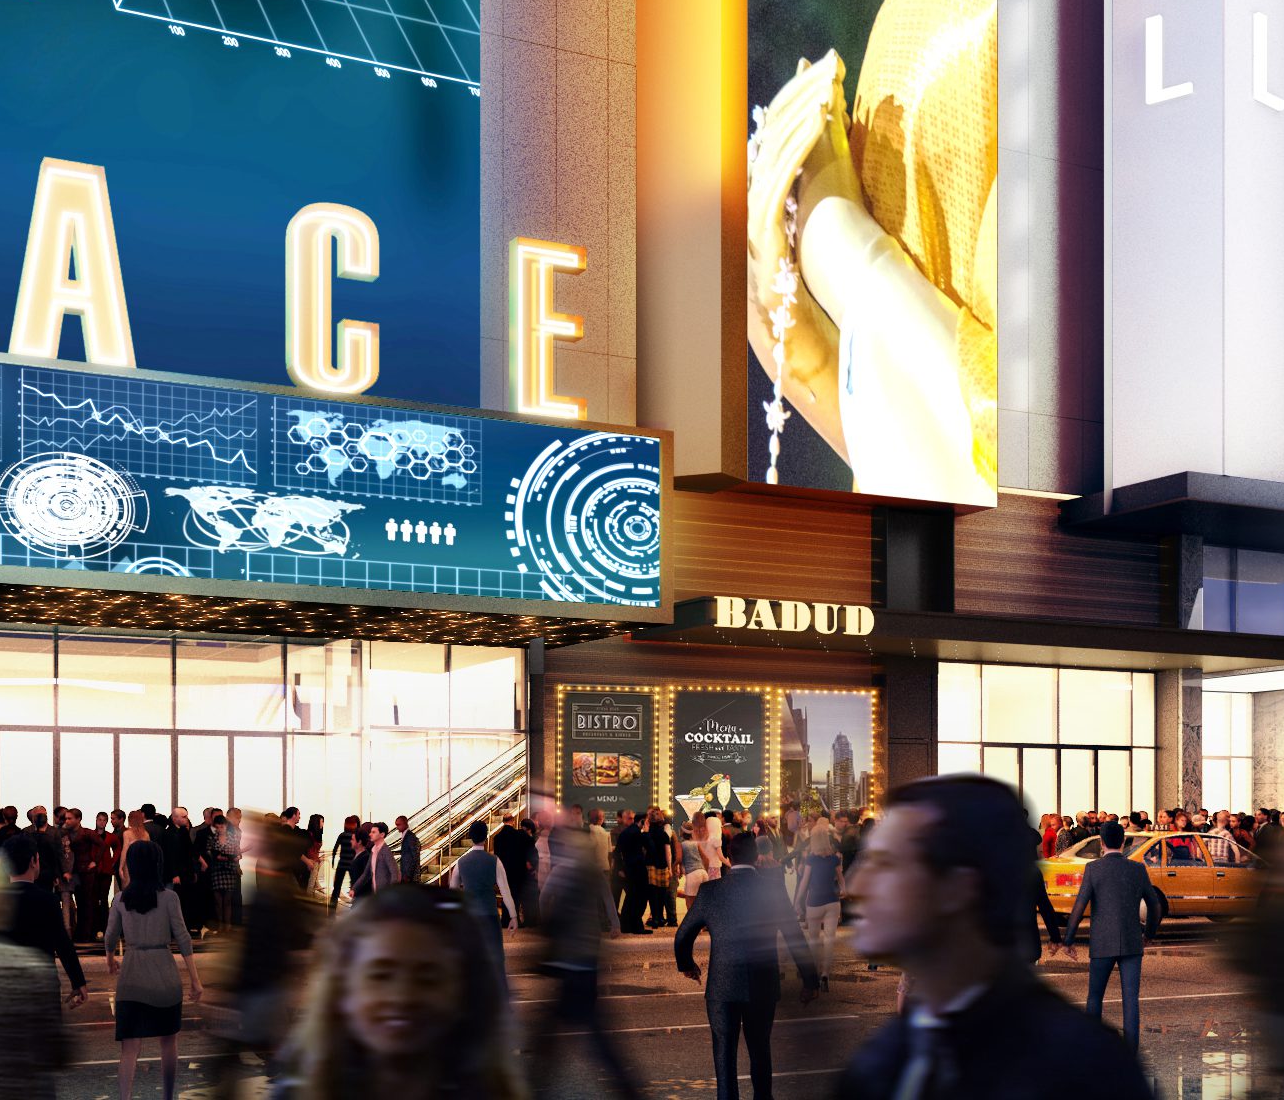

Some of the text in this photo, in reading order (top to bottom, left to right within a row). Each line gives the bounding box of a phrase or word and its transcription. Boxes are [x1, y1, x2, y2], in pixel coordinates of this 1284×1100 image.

[168, 24, 186, 37] 100
[222, 35, 239, 48] 200
[274, 46, 291, 59] 300
[325, 57, 342, 69] 400
[374, 67, 390, 79] 500
[714, 595, 875, 636] BADUD
[577, 714, 637, 730] BISTRO
[702, 719, 737, 733] Menu
[684, 732, 754, 744] COCKTAIL
[691, 743, 714, 751] FRESH
